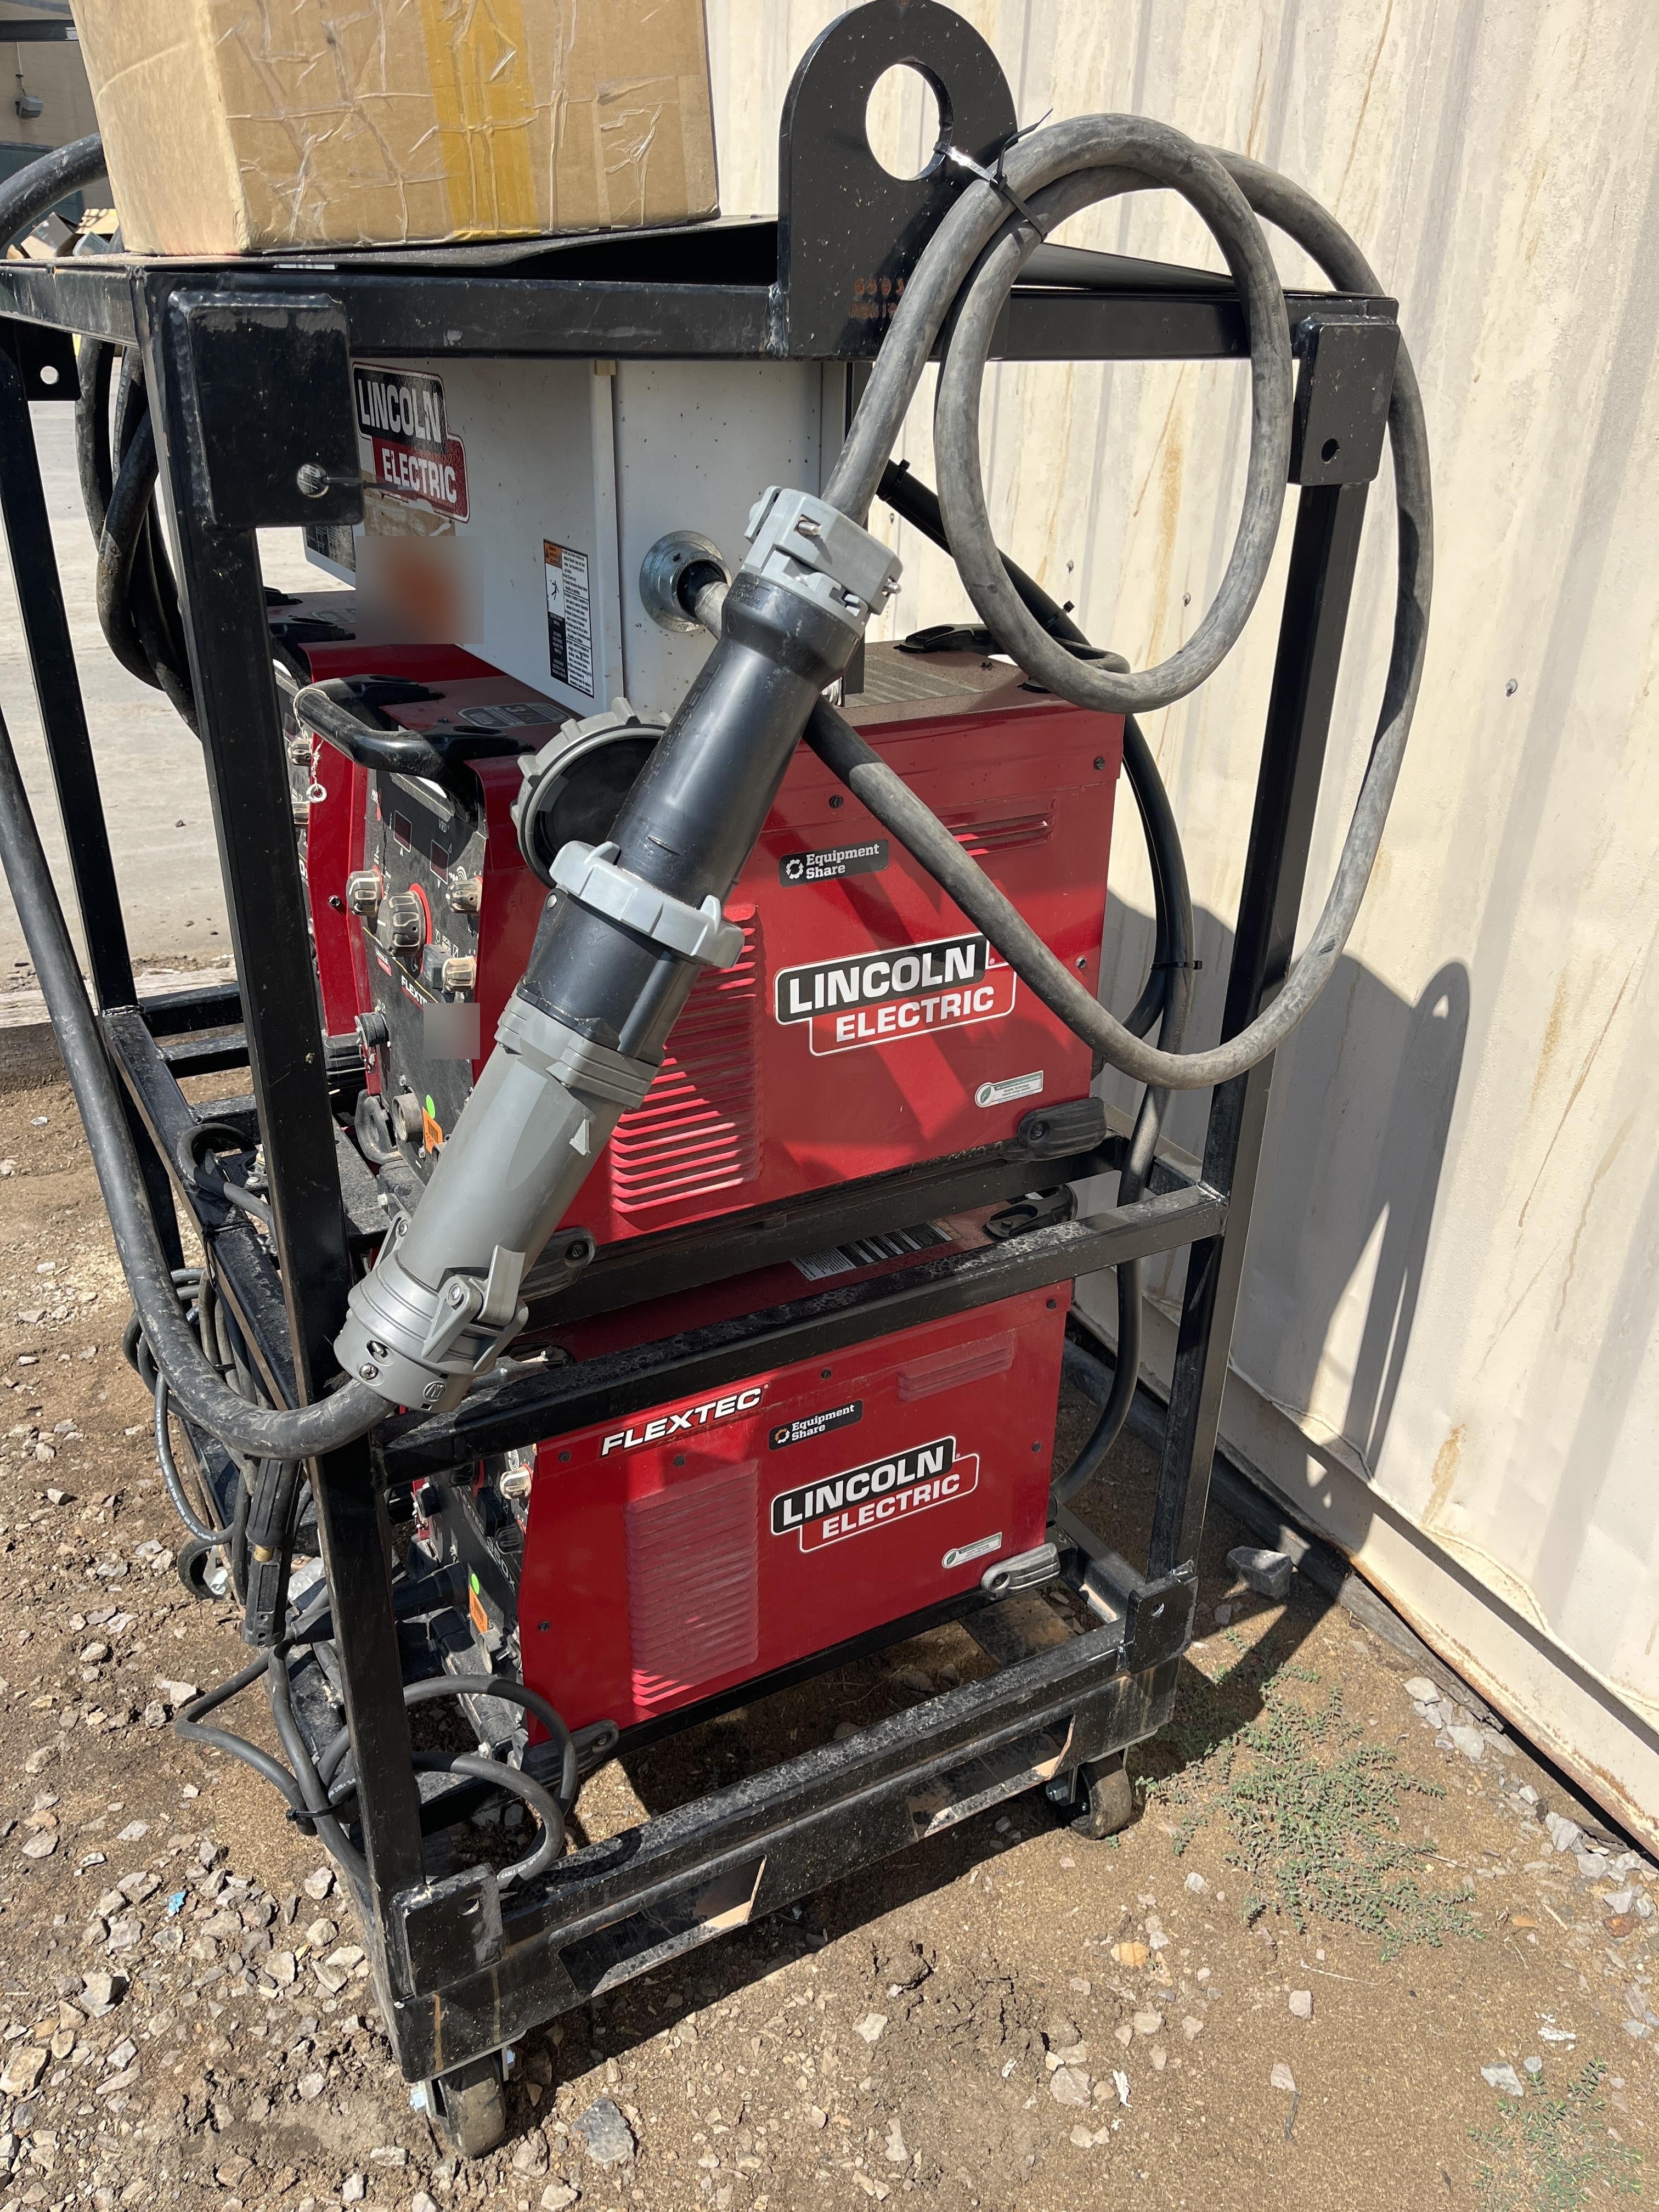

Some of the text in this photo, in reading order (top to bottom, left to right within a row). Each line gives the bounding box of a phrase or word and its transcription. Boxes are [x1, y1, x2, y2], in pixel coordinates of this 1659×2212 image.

[358, 379, 441, 443] LINCOLN
[382, 448, 456, 504] ELECTRIC
[805, 843, 880, 867] Equipment
[805, 864, 846, 879] Share
[789, 944, 976, 1014] LINCOLN
[836, 986, 994, 1043] ELECTRIC
[601, 1388, 761, 1457] FLEXTEC
[791, 1404, 855, 1432] Equipment
[791, 1423, 826, 1442] Share
[782, 1446, 945, 1527] LINCOLN
[822, 1473, 961, 1540] ELECTRIC
